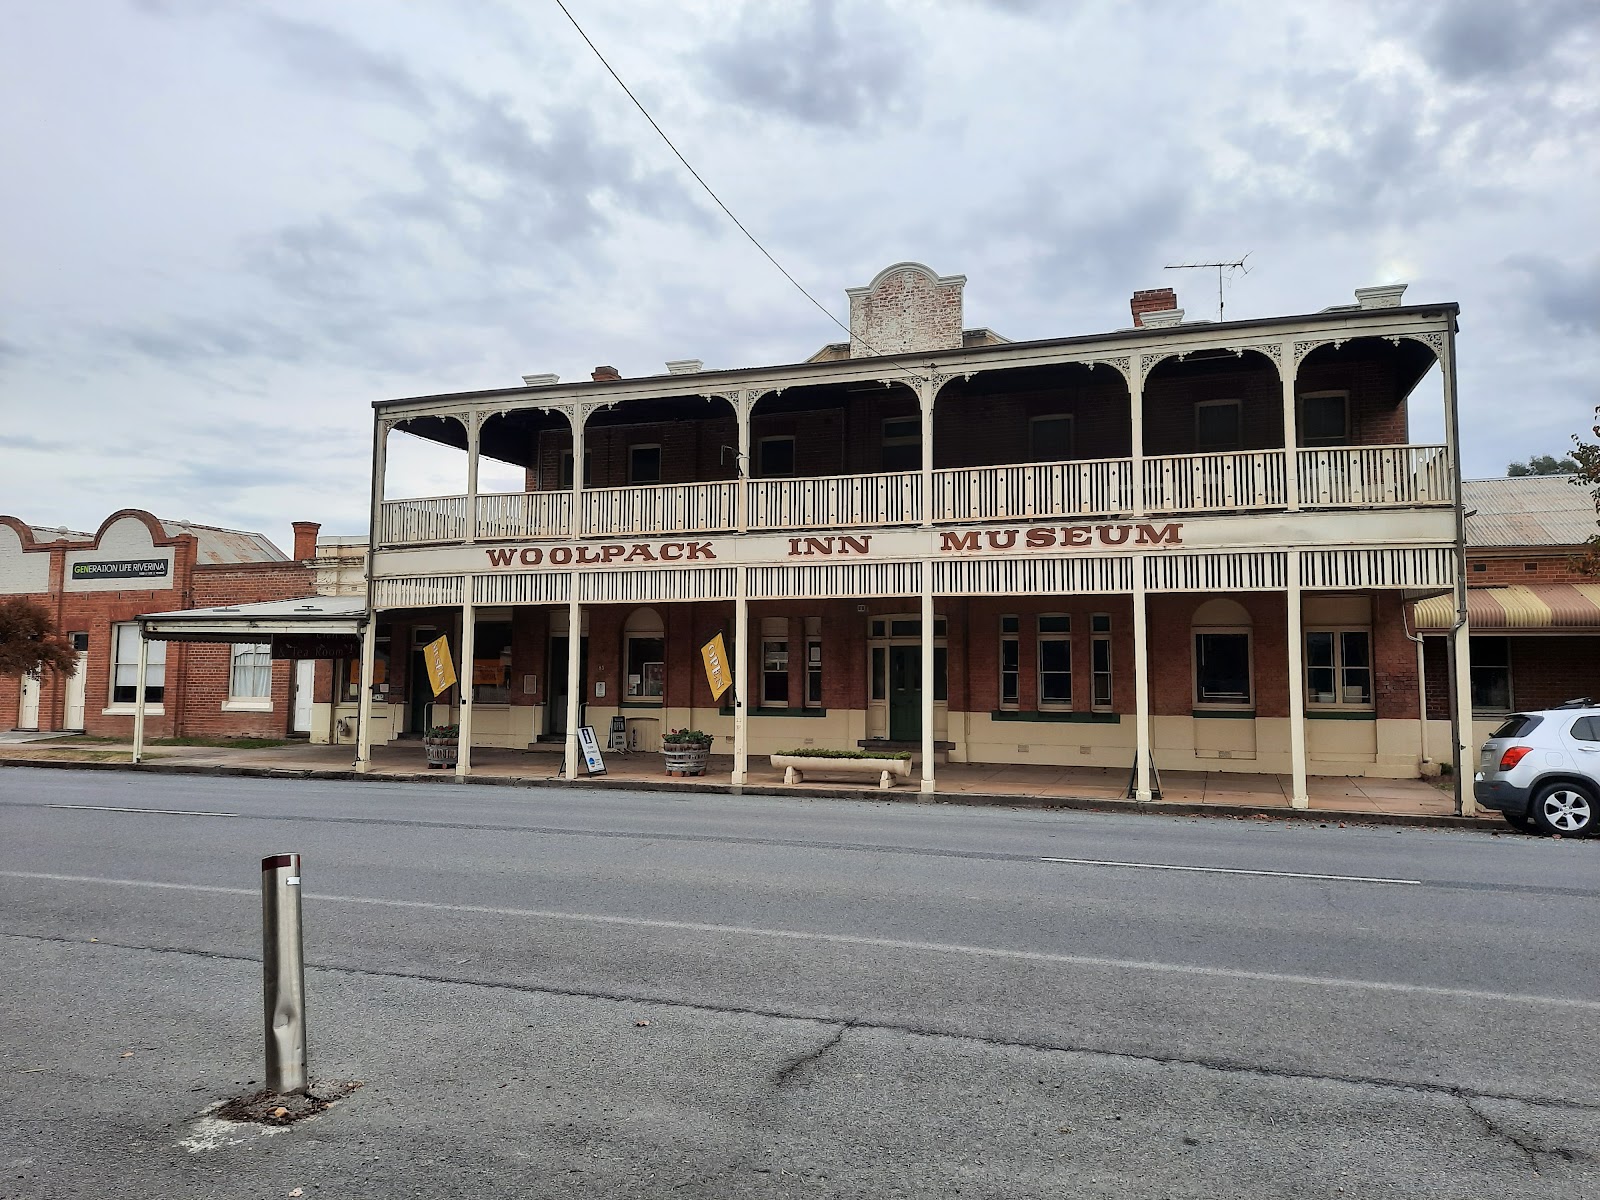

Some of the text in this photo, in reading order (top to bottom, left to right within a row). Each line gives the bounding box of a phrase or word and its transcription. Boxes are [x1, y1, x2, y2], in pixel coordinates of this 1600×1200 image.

[485, 523, 1184, 567] WOOLPACK INN MUSEUM
[74, 562, 165, 574] GENERATION LIFE RIVERINA
[291, 646, 309, 657] Tea
[315, 646, 344, 657] Room
[708, 643, 725, 690] OPEN
